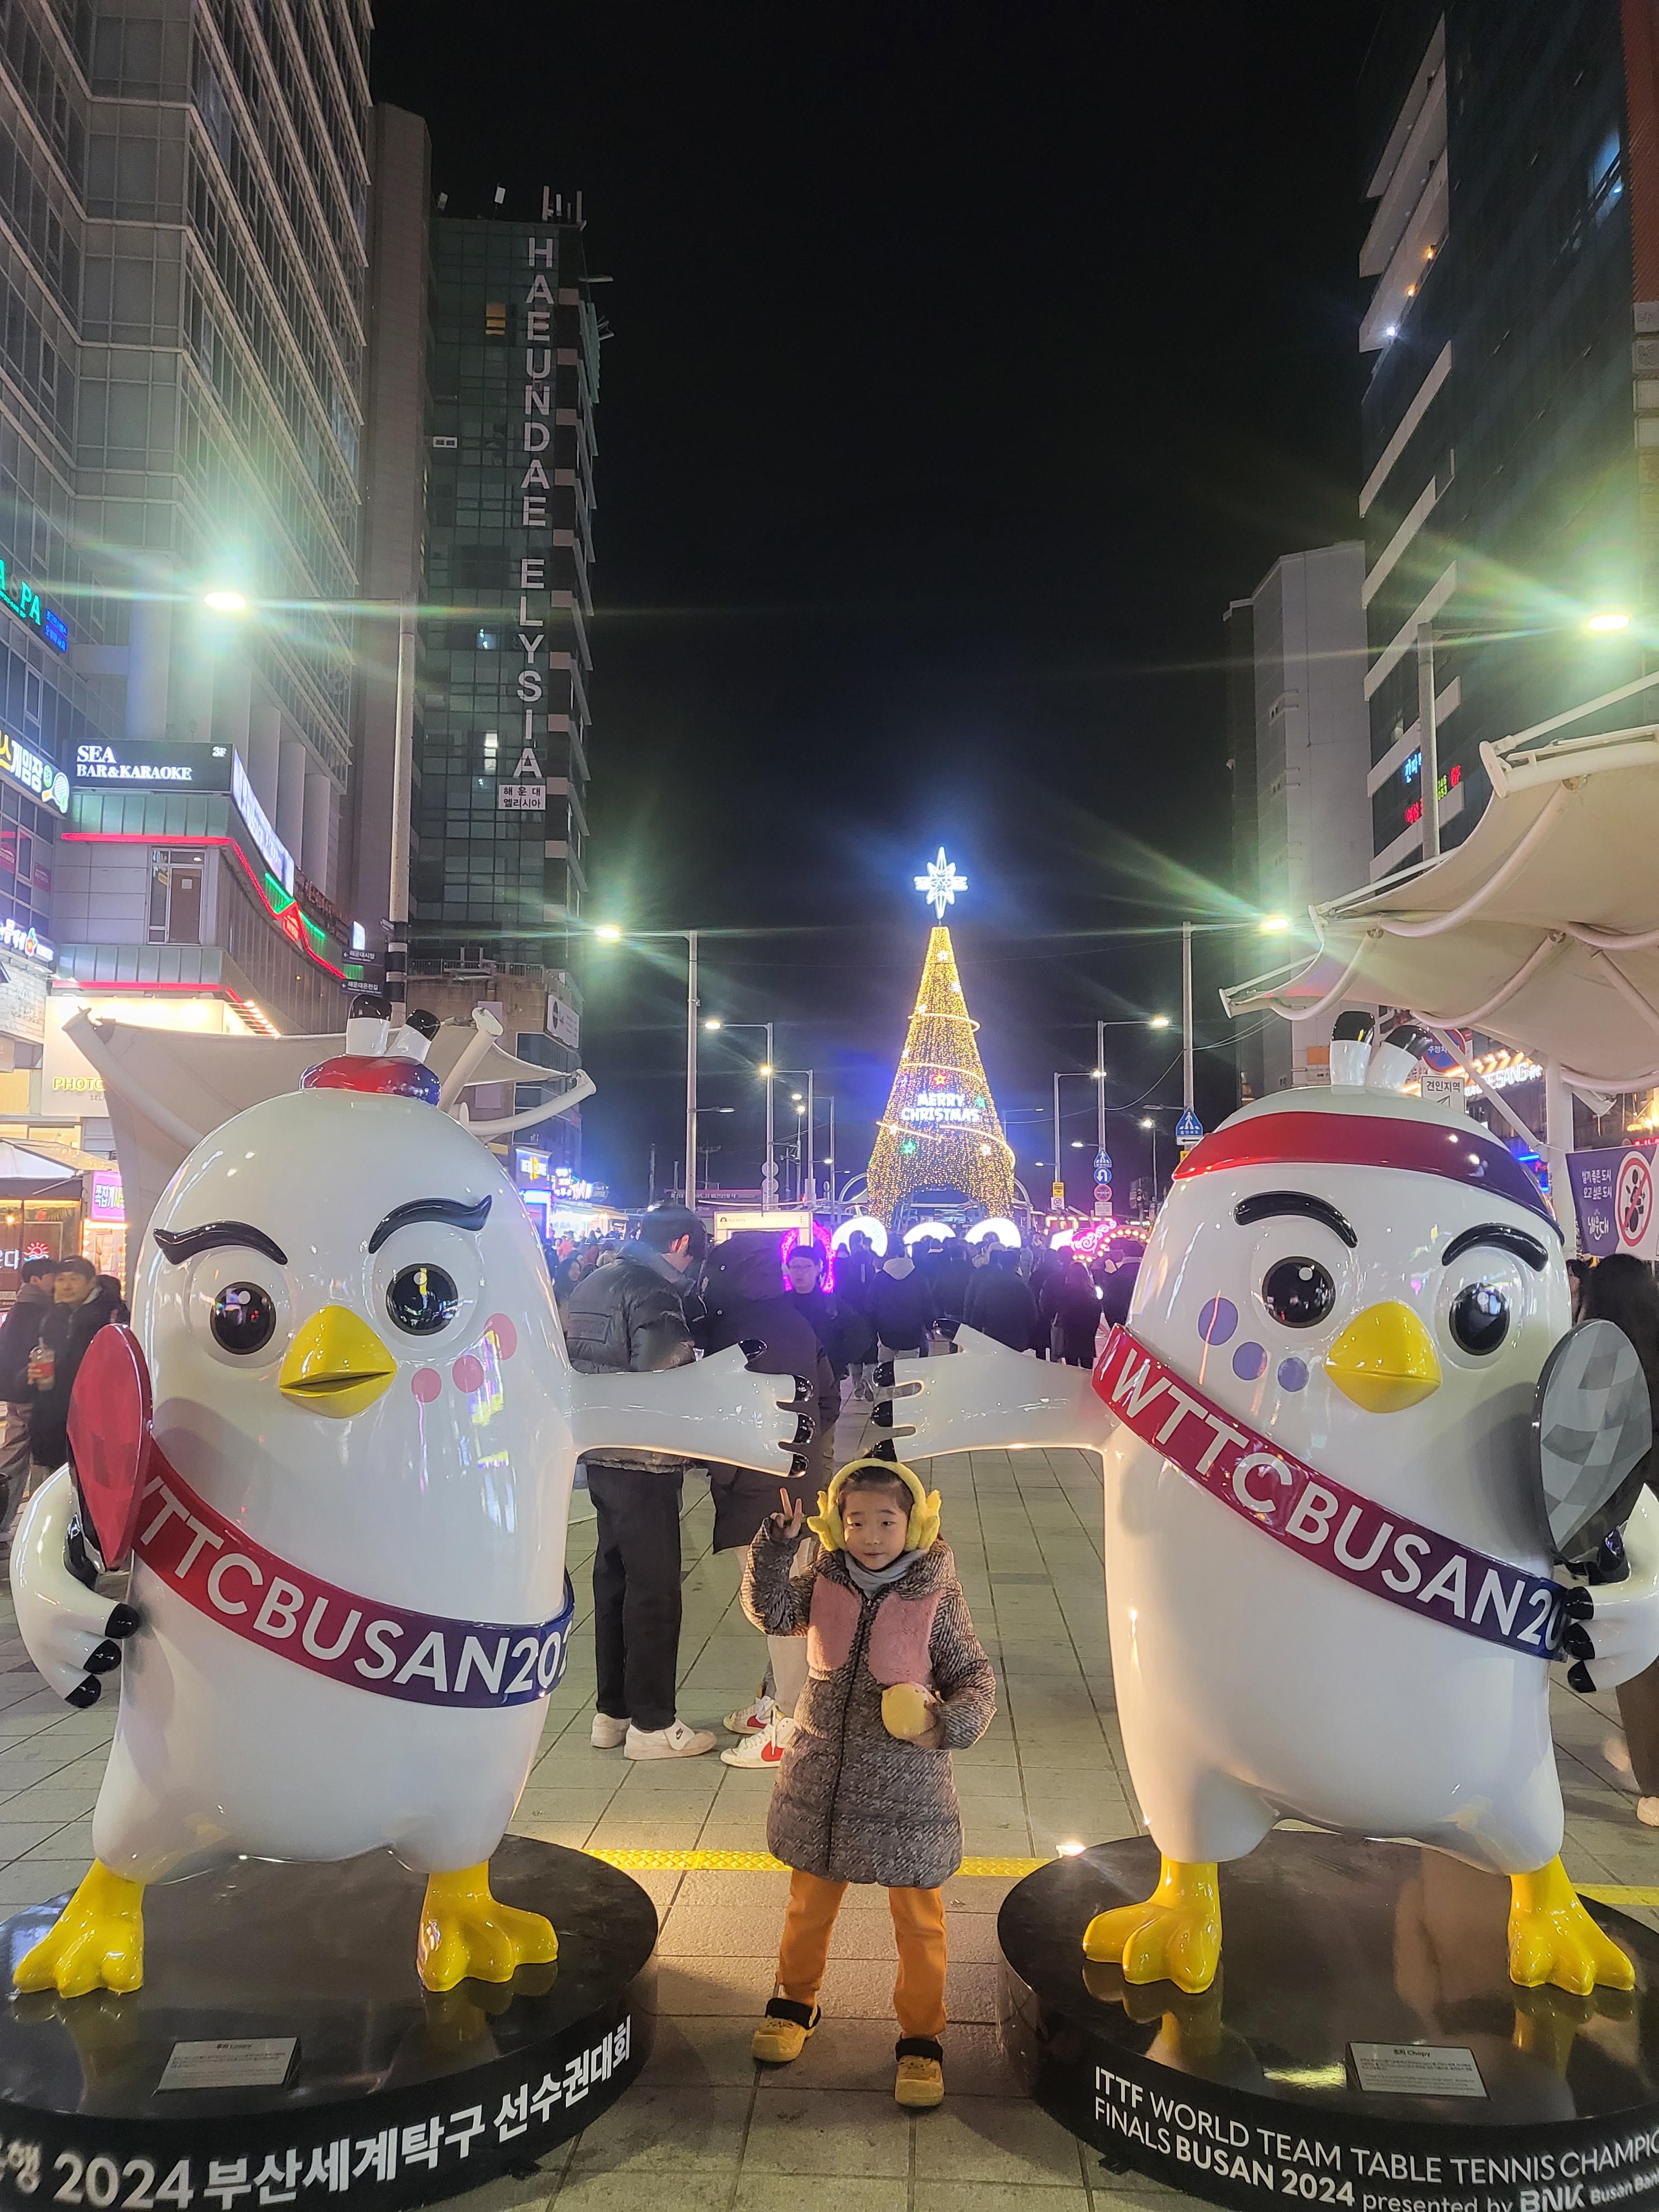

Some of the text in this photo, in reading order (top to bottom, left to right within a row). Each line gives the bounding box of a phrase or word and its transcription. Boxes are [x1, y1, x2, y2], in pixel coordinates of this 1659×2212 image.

[513, 237, 554, 779] HAEUNDAE ELYSIA
[76, 745, 117, 764] SEA
[212, 746, 227, 758] 3F
[76, 764, 192, 781] BAR&KARAOKE
[503, 786, 541, 797] 해운대
[503, 798, 541, 808] 엘리시아
[349, 951, 375, 960] 해운대시장
[1426, 1080, 1460, 1092] 견인지역
[917, 1093, 965, 1107] MERRY
[901, 1107, 979, 1121] CHRISTMAS
[1601, 1168, 1611, 1182] 도시
[1602, 1186, 1613, 1199] 도시
[140, 1475, 572, 1694] TTCBUSAN20
[0, 2015, 631, 2210] 행 2024 부산세계탁구 선수권대회
[1095, 2065, 1143, 2109] ITTF
[1150, 2091, 1249, 2147] WORLD
[1256, 2128, 1341, 2172] TEAM
[1350, 2148, 1442, 2183] TABLE
[1449, 2156, 1556, 2185] TENNIS
[1095, 2096, 1171, 2154] FINALS
[1176, 2133, 1274, 2190] BUSAN
[1281, 2168, 1355, 2207] 2024
[1363, 2193, 1478, 2212] presented
[1521, 2183, 1586, 2212] BNK
[1590, 2179, 1634, 2205] Busan
